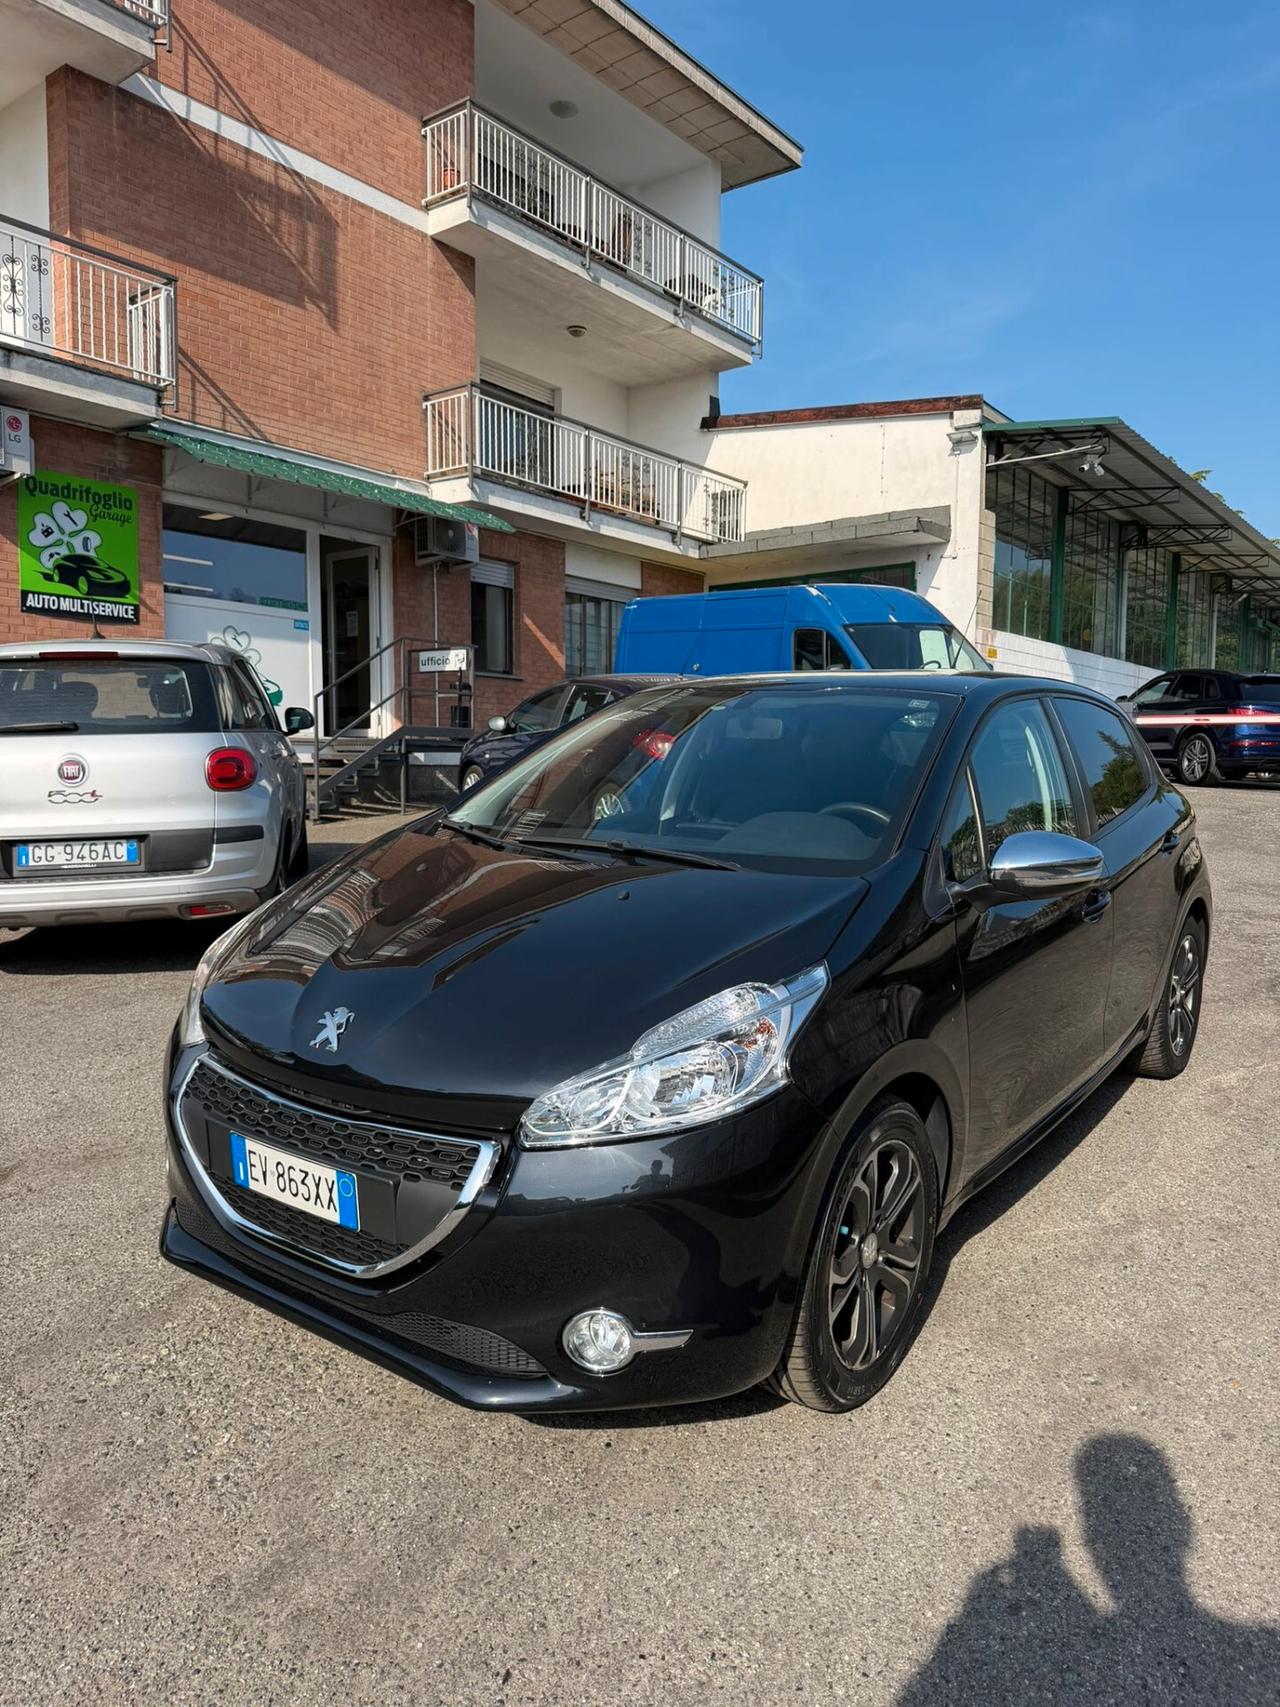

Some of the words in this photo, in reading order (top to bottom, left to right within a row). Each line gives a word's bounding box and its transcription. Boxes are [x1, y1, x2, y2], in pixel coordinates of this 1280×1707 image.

[8, 433, 21, 443] LG
[24, 475, 133, 511] Quadrifoglio
[89, 503, 133, 527] Garage
[26, 593, 58, 610] AUTO
[60, 597, 135, 619] MULTISERVICE
[421, 656, 450, 666] ufficio
[63, 841, 124, 862] 946AC
[248, 1149, 268, 1186] EV
[275, 1160, 338, 1213] 863XX
